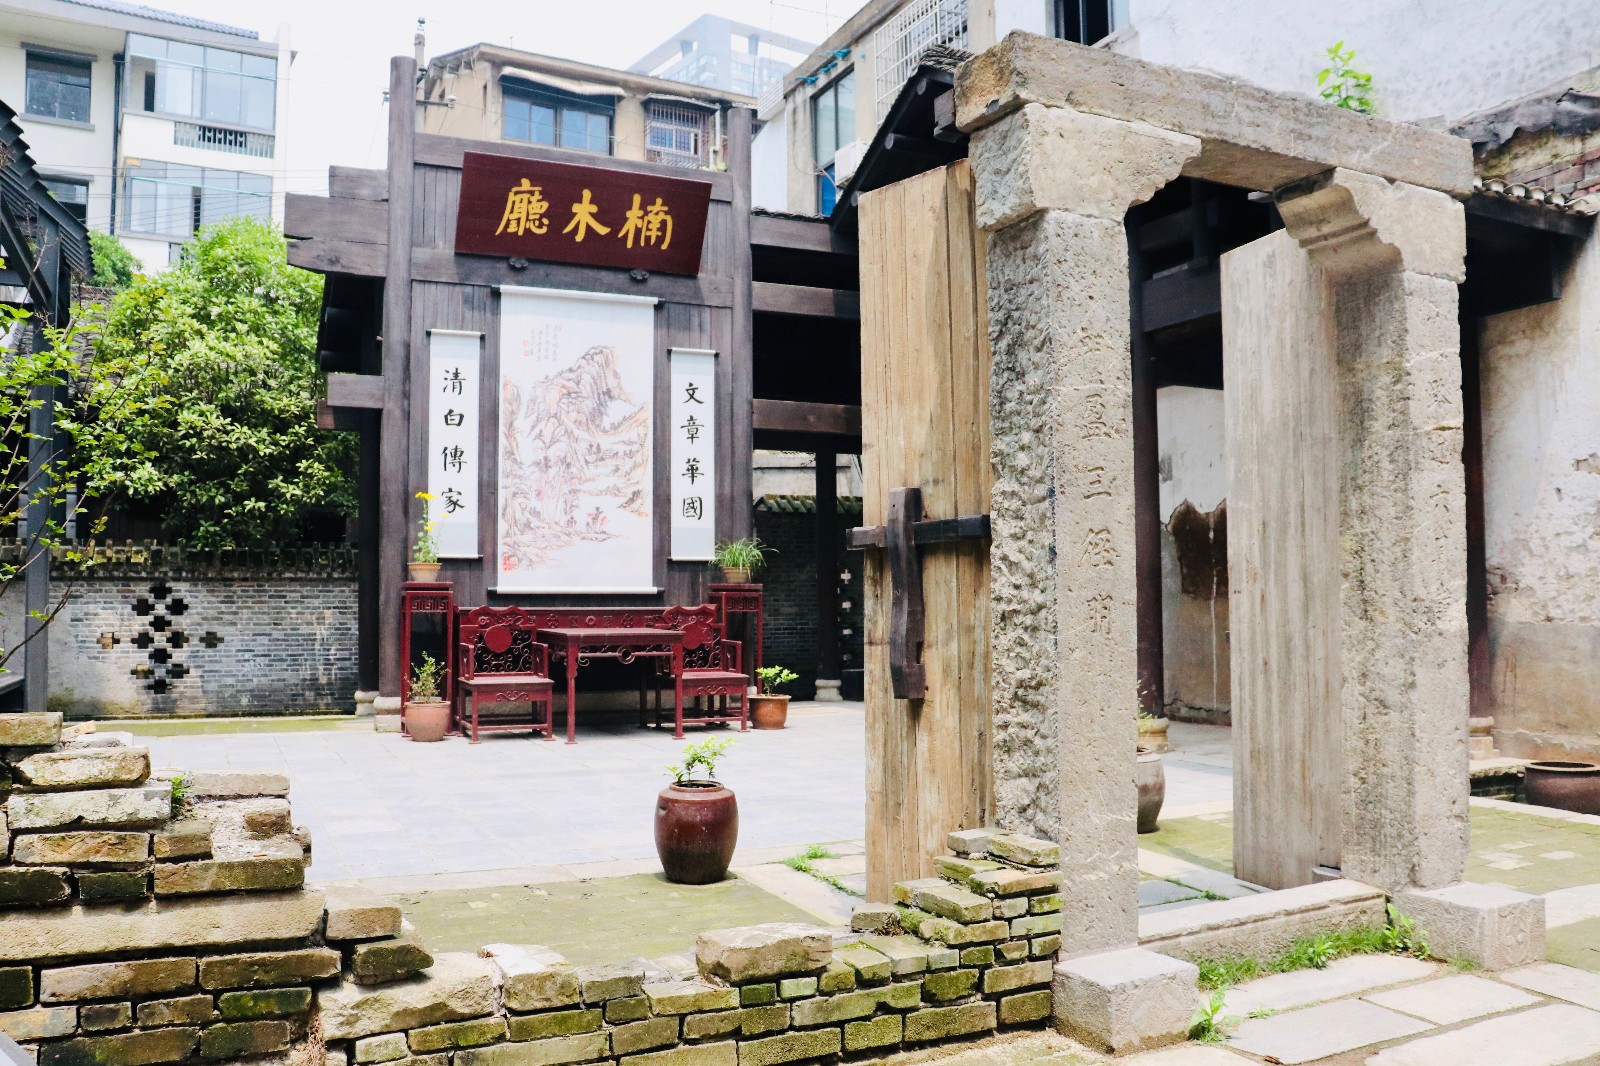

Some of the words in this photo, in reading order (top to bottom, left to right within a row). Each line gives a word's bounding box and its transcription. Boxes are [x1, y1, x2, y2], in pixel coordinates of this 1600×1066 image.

[441, 367, 467, 514] 清白傳家
[680, 382, 705, 521] 文章華國
